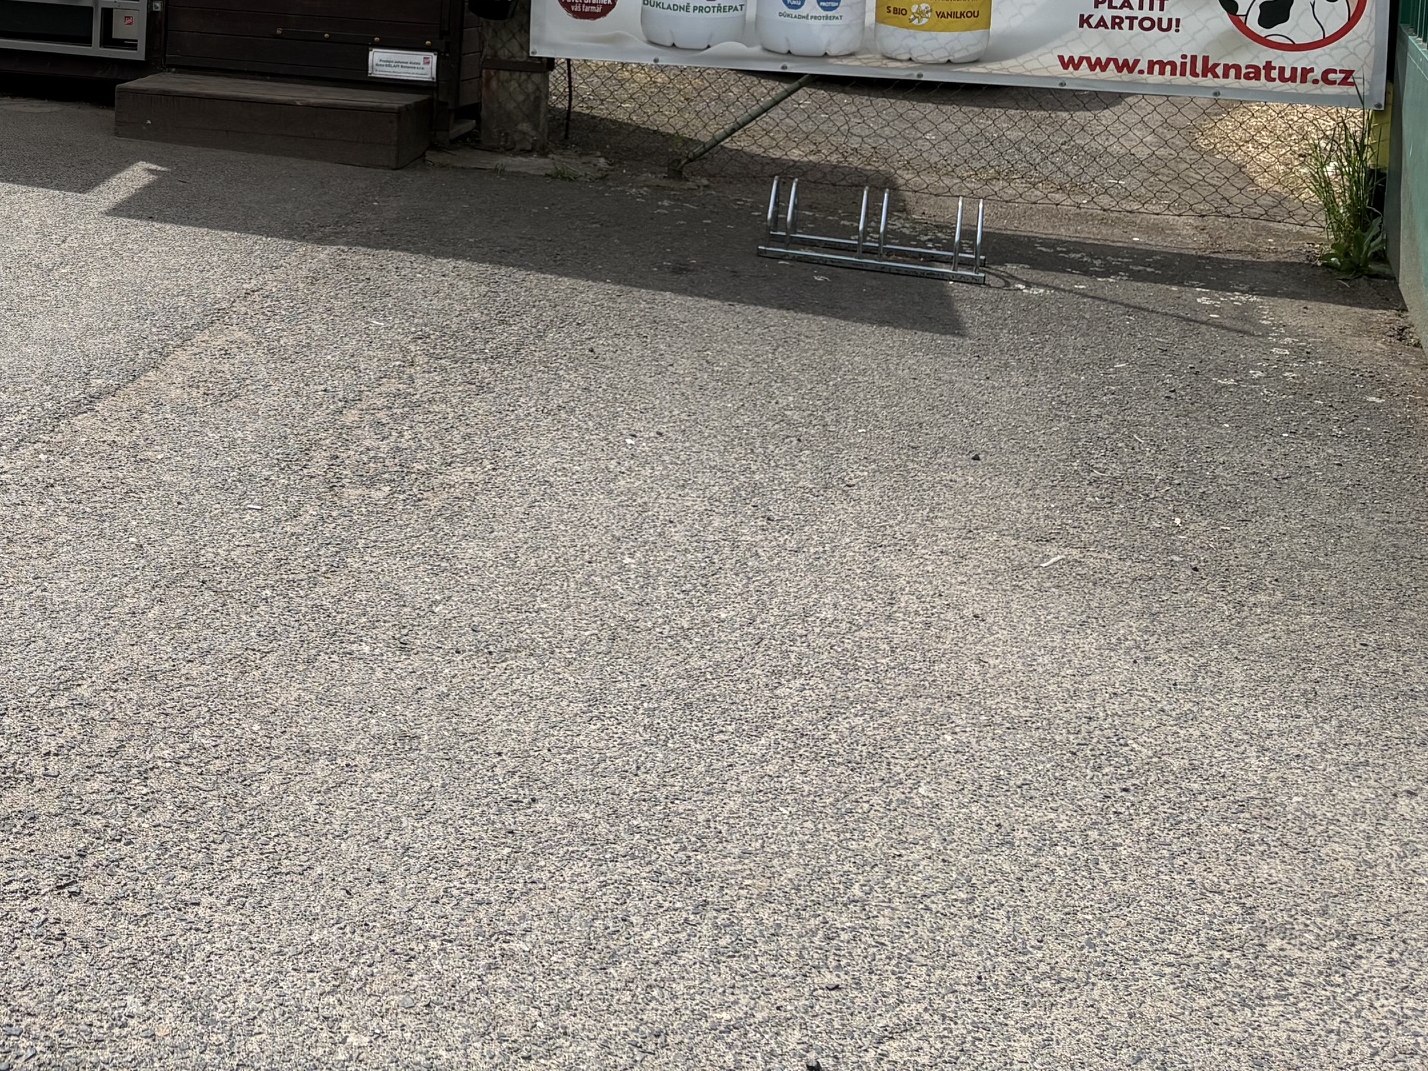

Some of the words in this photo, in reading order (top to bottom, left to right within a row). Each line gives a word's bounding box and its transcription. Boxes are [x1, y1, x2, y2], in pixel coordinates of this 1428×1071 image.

[571, 3, 582, 12] váš
[582, 4, 603, 12] farmář
[692, 3, 745, 14] PROTŘEPAT
[886, 5, 892, 14] S
[892, 6, 908, 16] BIO
[935, 10, 980, 19] VANILKOU
[778, 11, 809, 20] DŮKLADNĚ
[810, 13, 843, 21] PROTŘEPAT
[1078, 13, 1181, 34] KARTOU!
[1057, 53, 1356, 87] www.milknatur.cz
